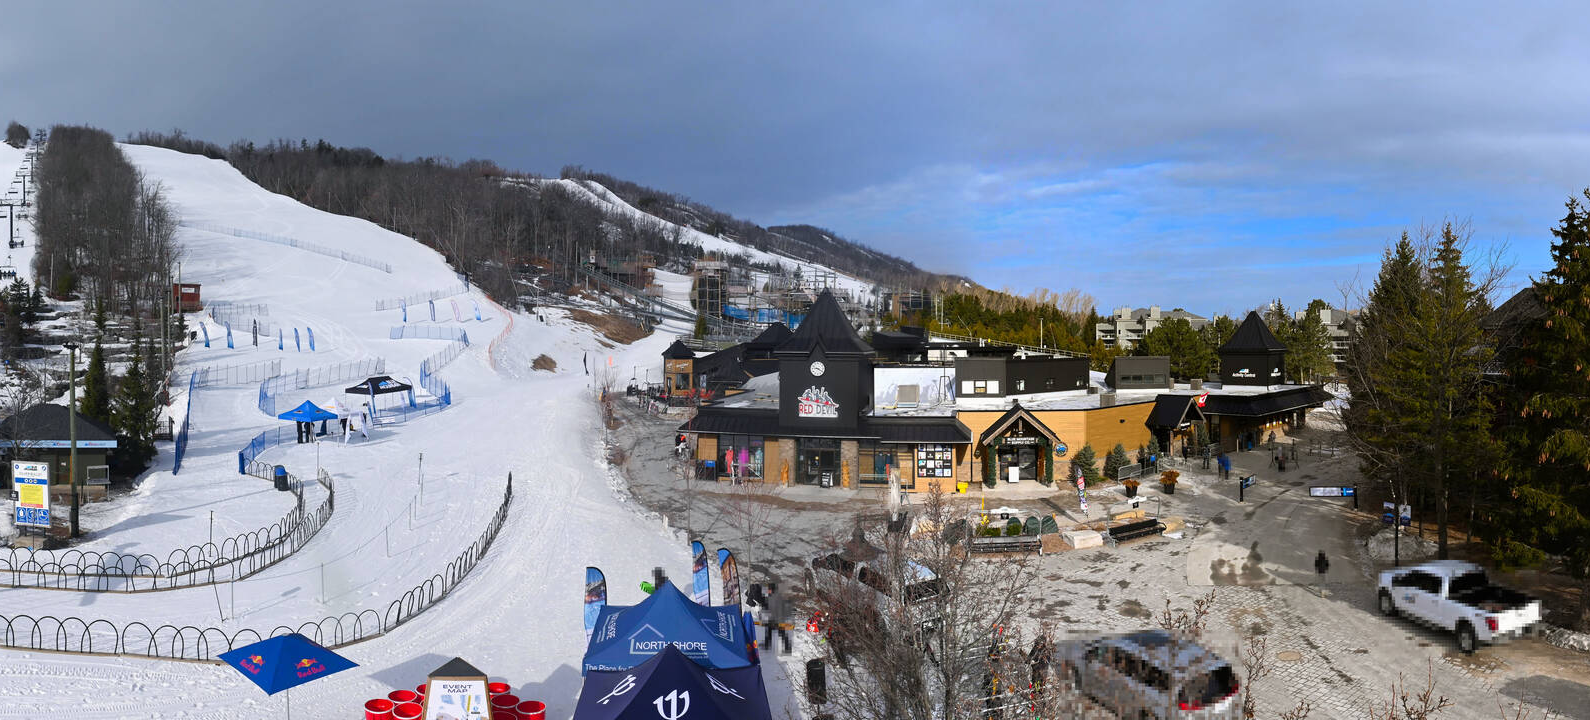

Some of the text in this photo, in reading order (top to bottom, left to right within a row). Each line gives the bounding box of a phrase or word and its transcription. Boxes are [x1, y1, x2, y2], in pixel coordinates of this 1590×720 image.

[799, 403, 837, 415] RED DEVIL
[635, 642, 707, 651] NORTH SHORE
[297, 668, 311, 678] Red
